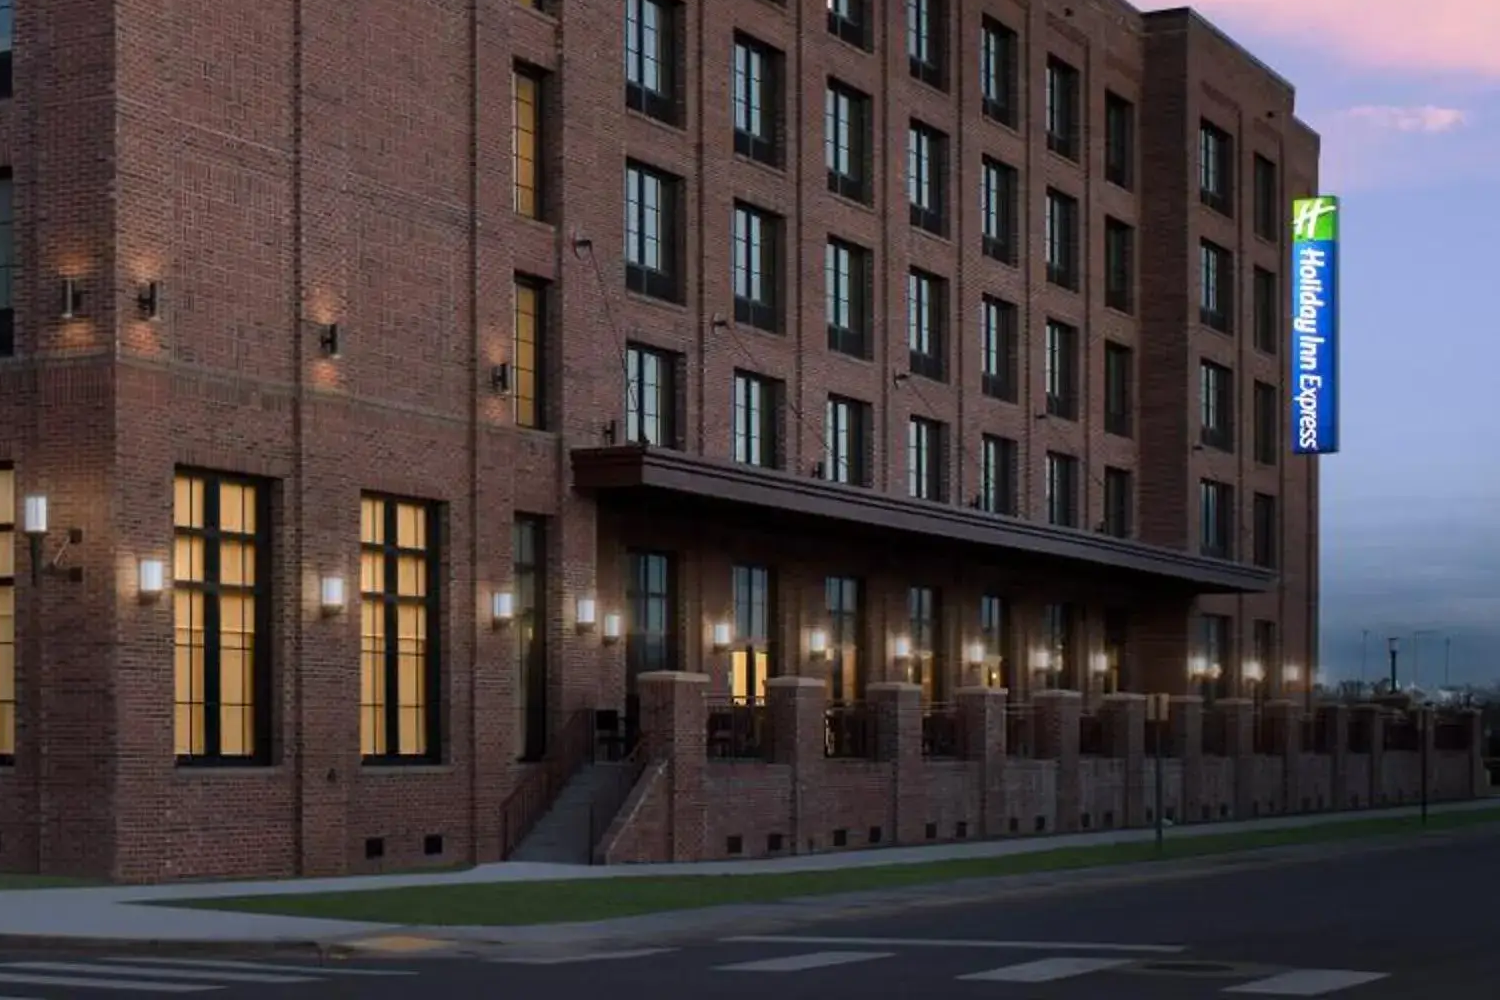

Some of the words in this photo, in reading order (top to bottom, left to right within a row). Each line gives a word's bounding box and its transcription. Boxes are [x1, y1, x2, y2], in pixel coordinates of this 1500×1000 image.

[1293, 248, 1325, 334] Holiday
[1300, 335, 1325, 371] Inn
[1293, 374, 1322, 450] Express
